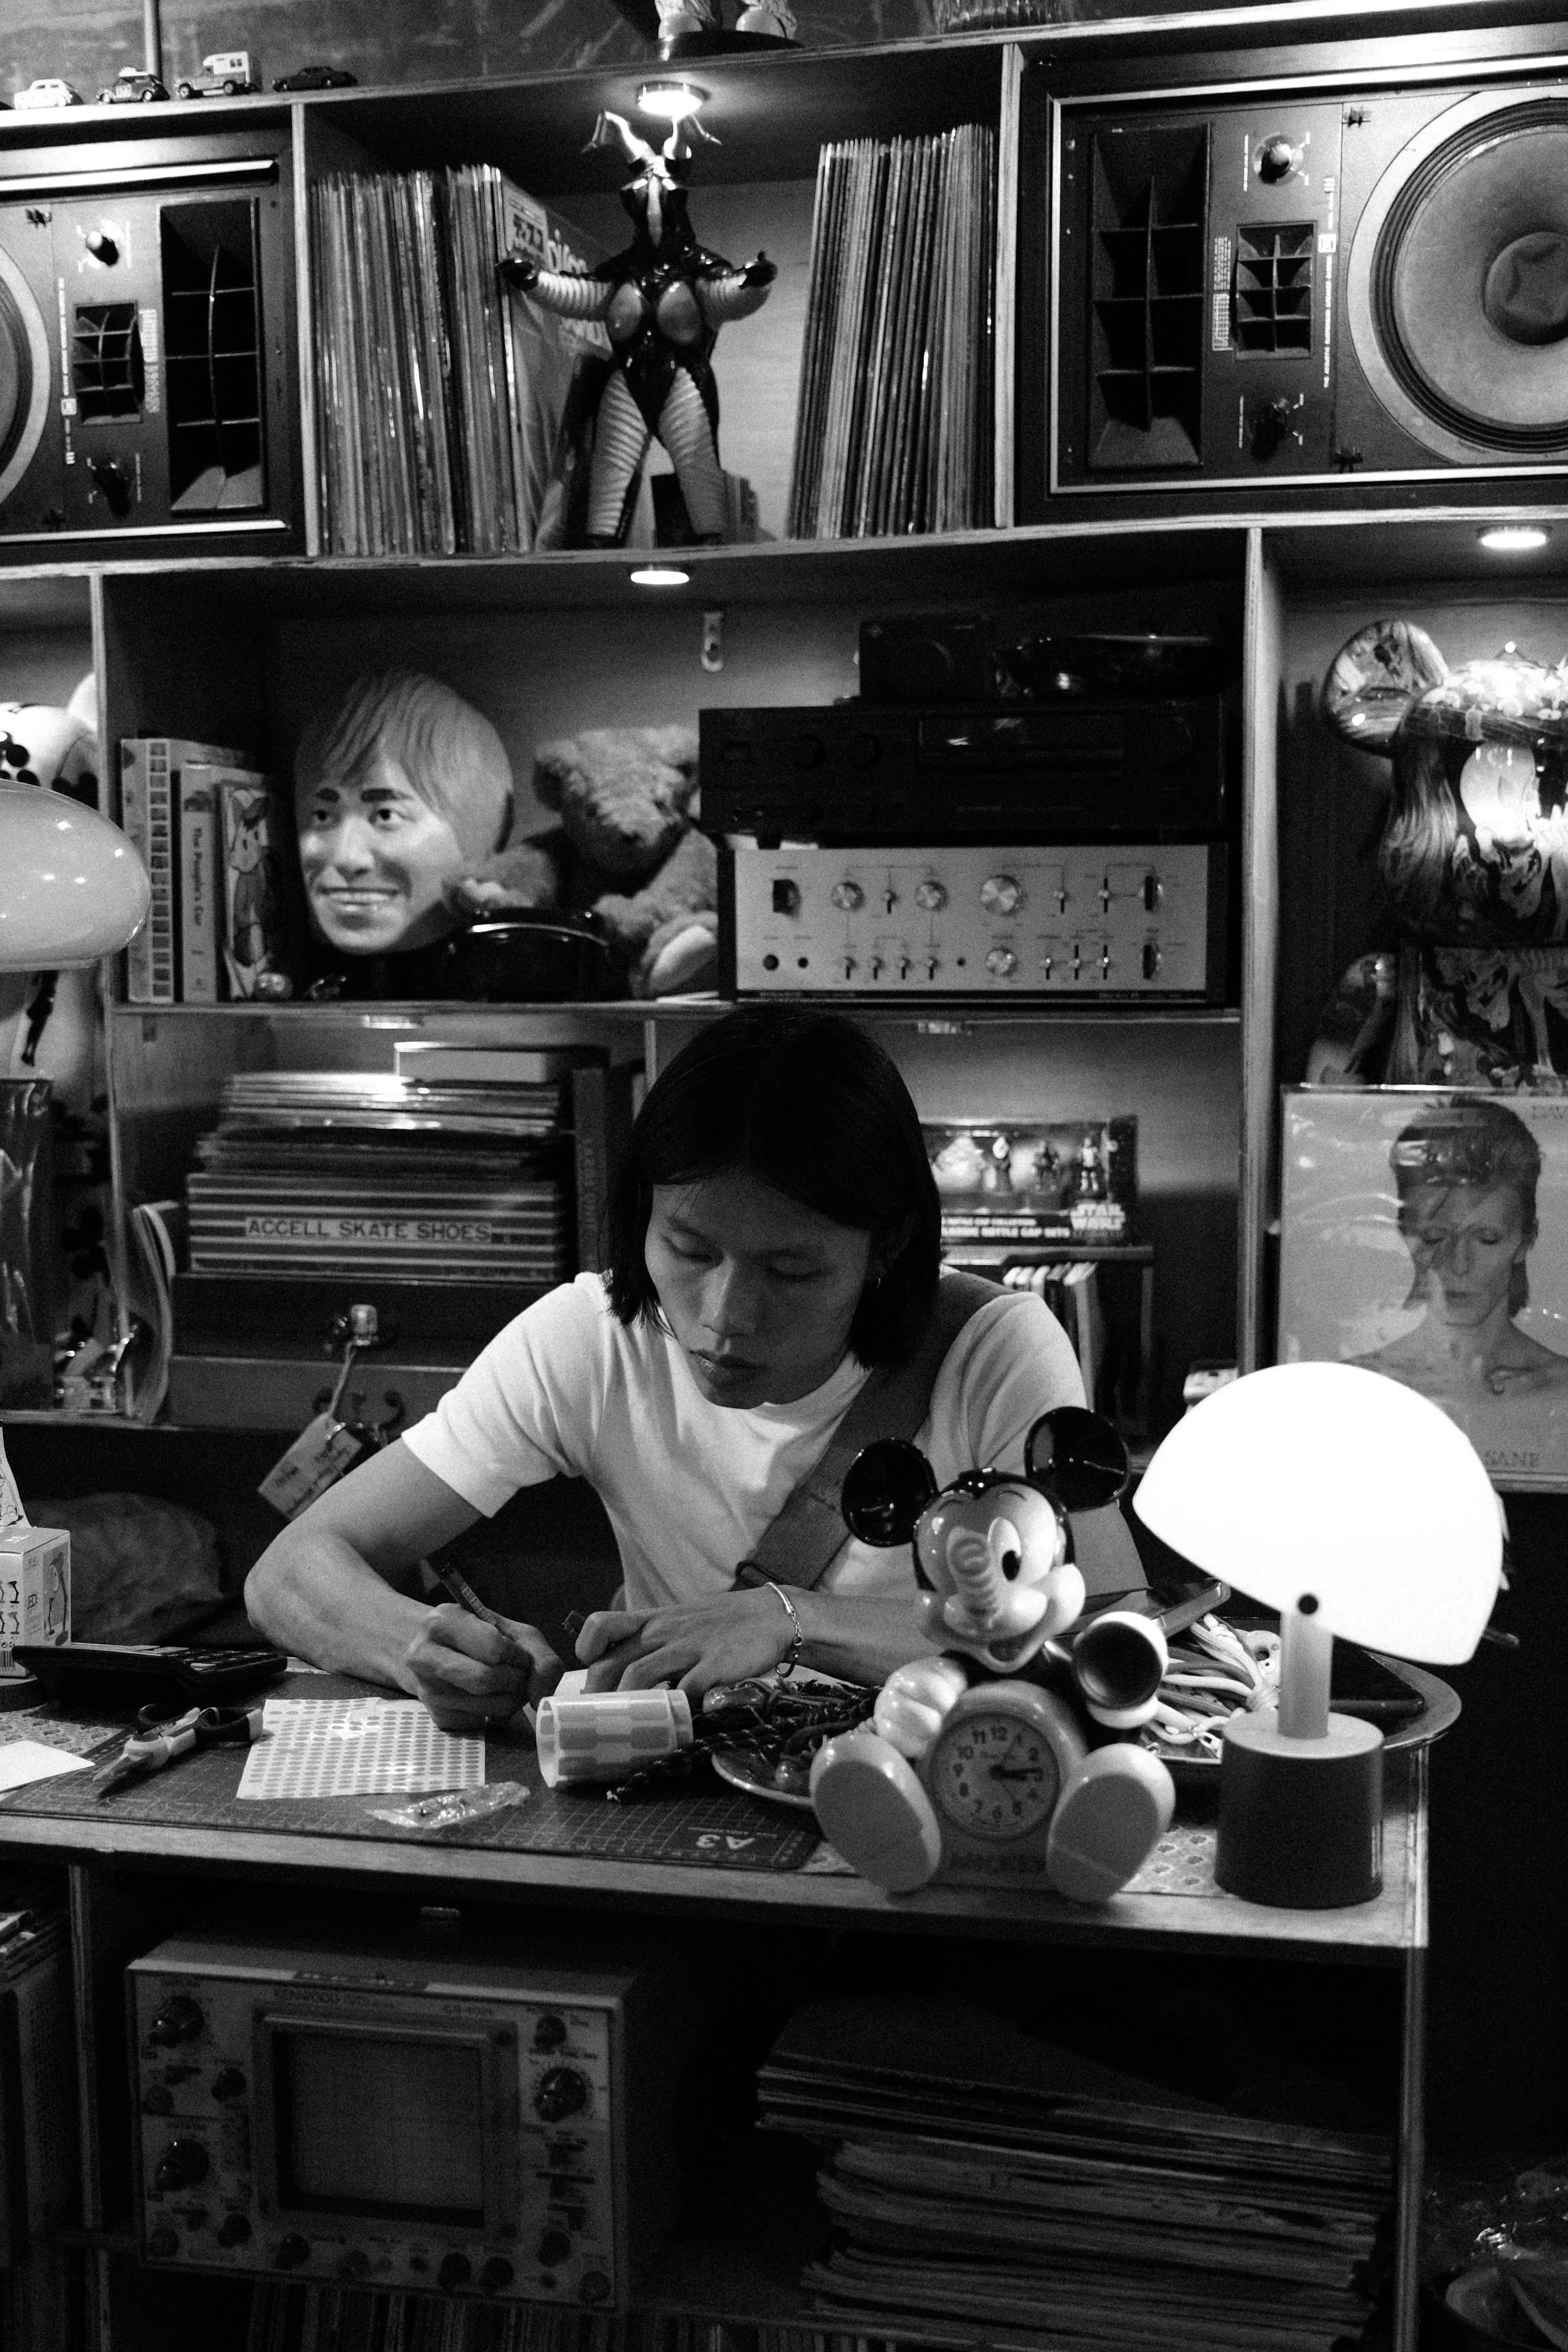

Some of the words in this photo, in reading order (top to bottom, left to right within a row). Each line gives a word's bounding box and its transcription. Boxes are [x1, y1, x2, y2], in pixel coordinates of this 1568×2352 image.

[248, 1219, 330, 1236] ACCELL
[339, 1220, 408, 1239] SKATE
[416, 1221, 490, 1241] SHOES
[1483, 1450, 1540, 1468] SANE
[973, 1730, 986, 1744] 11
[991, 1726, 1007, 1742] 12
[696, 1833, 755, 1851] A3
